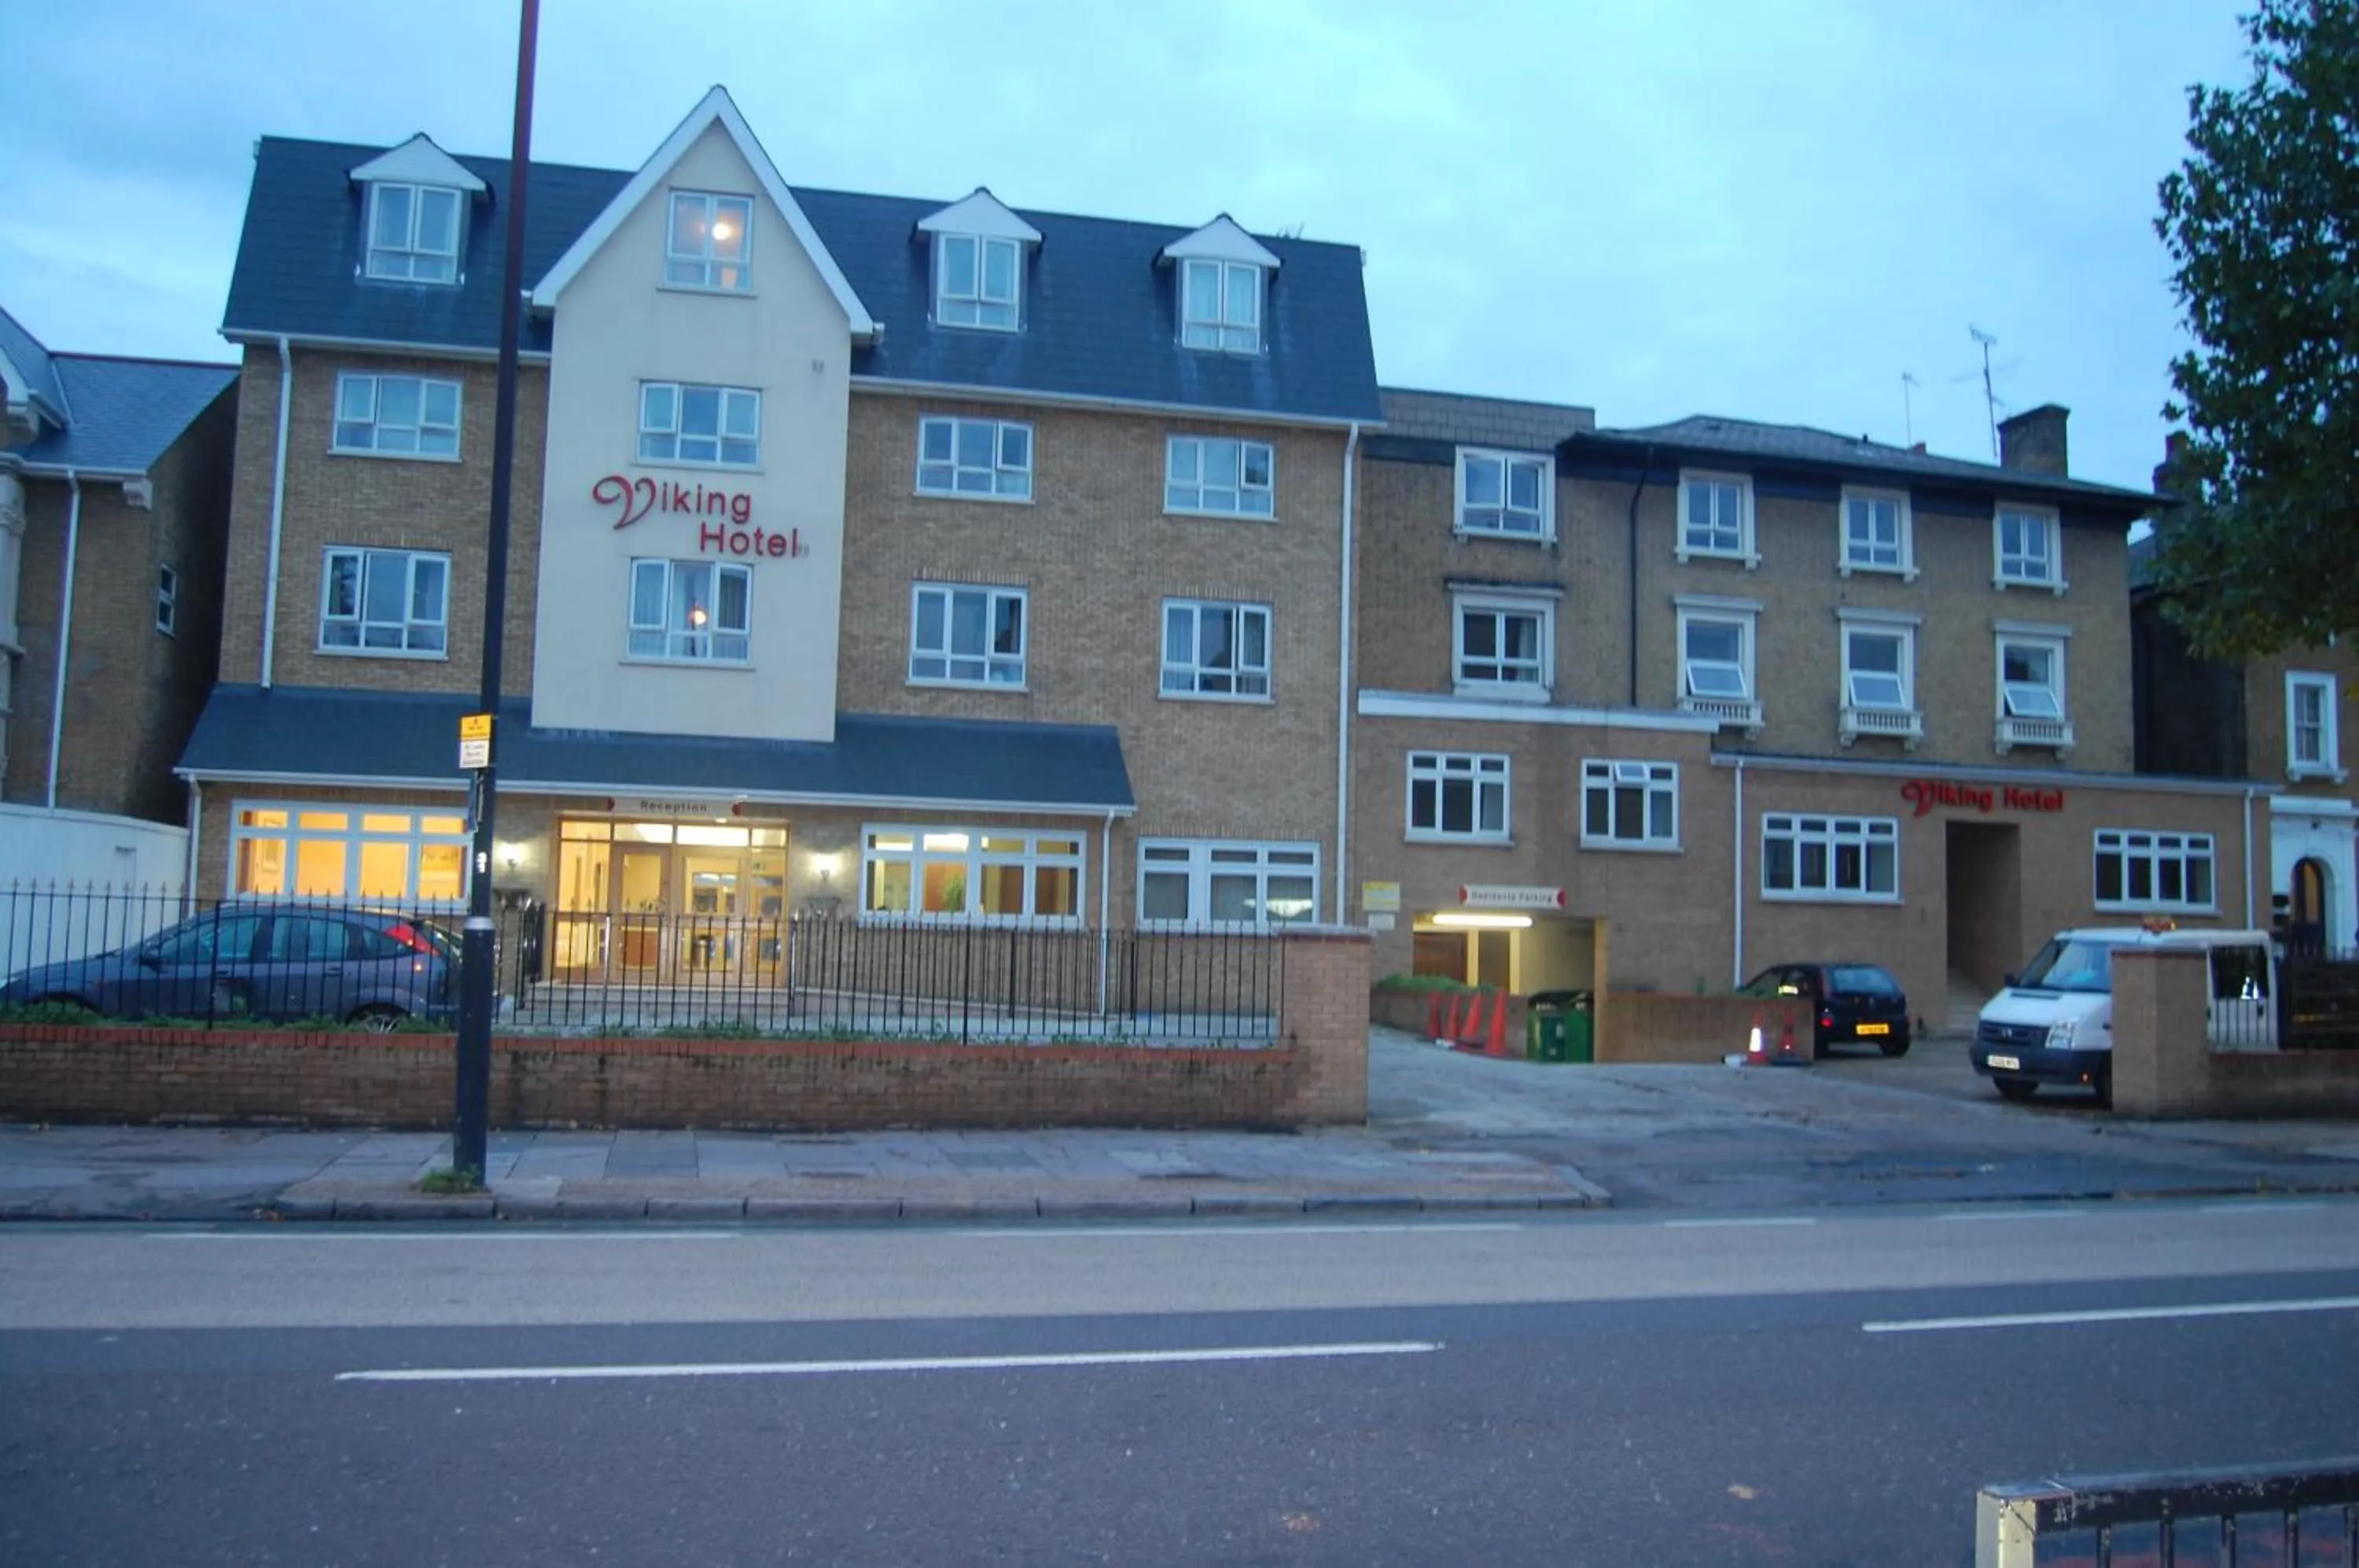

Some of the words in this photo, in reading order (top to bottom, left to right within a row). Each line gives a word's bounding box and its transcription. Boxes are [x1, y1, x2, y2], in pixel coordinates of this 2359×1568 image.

[592, 475, 752, 530] Viking
[698, 521, 797, 558] Hotel
[640, 801, 707, 813] Reception
